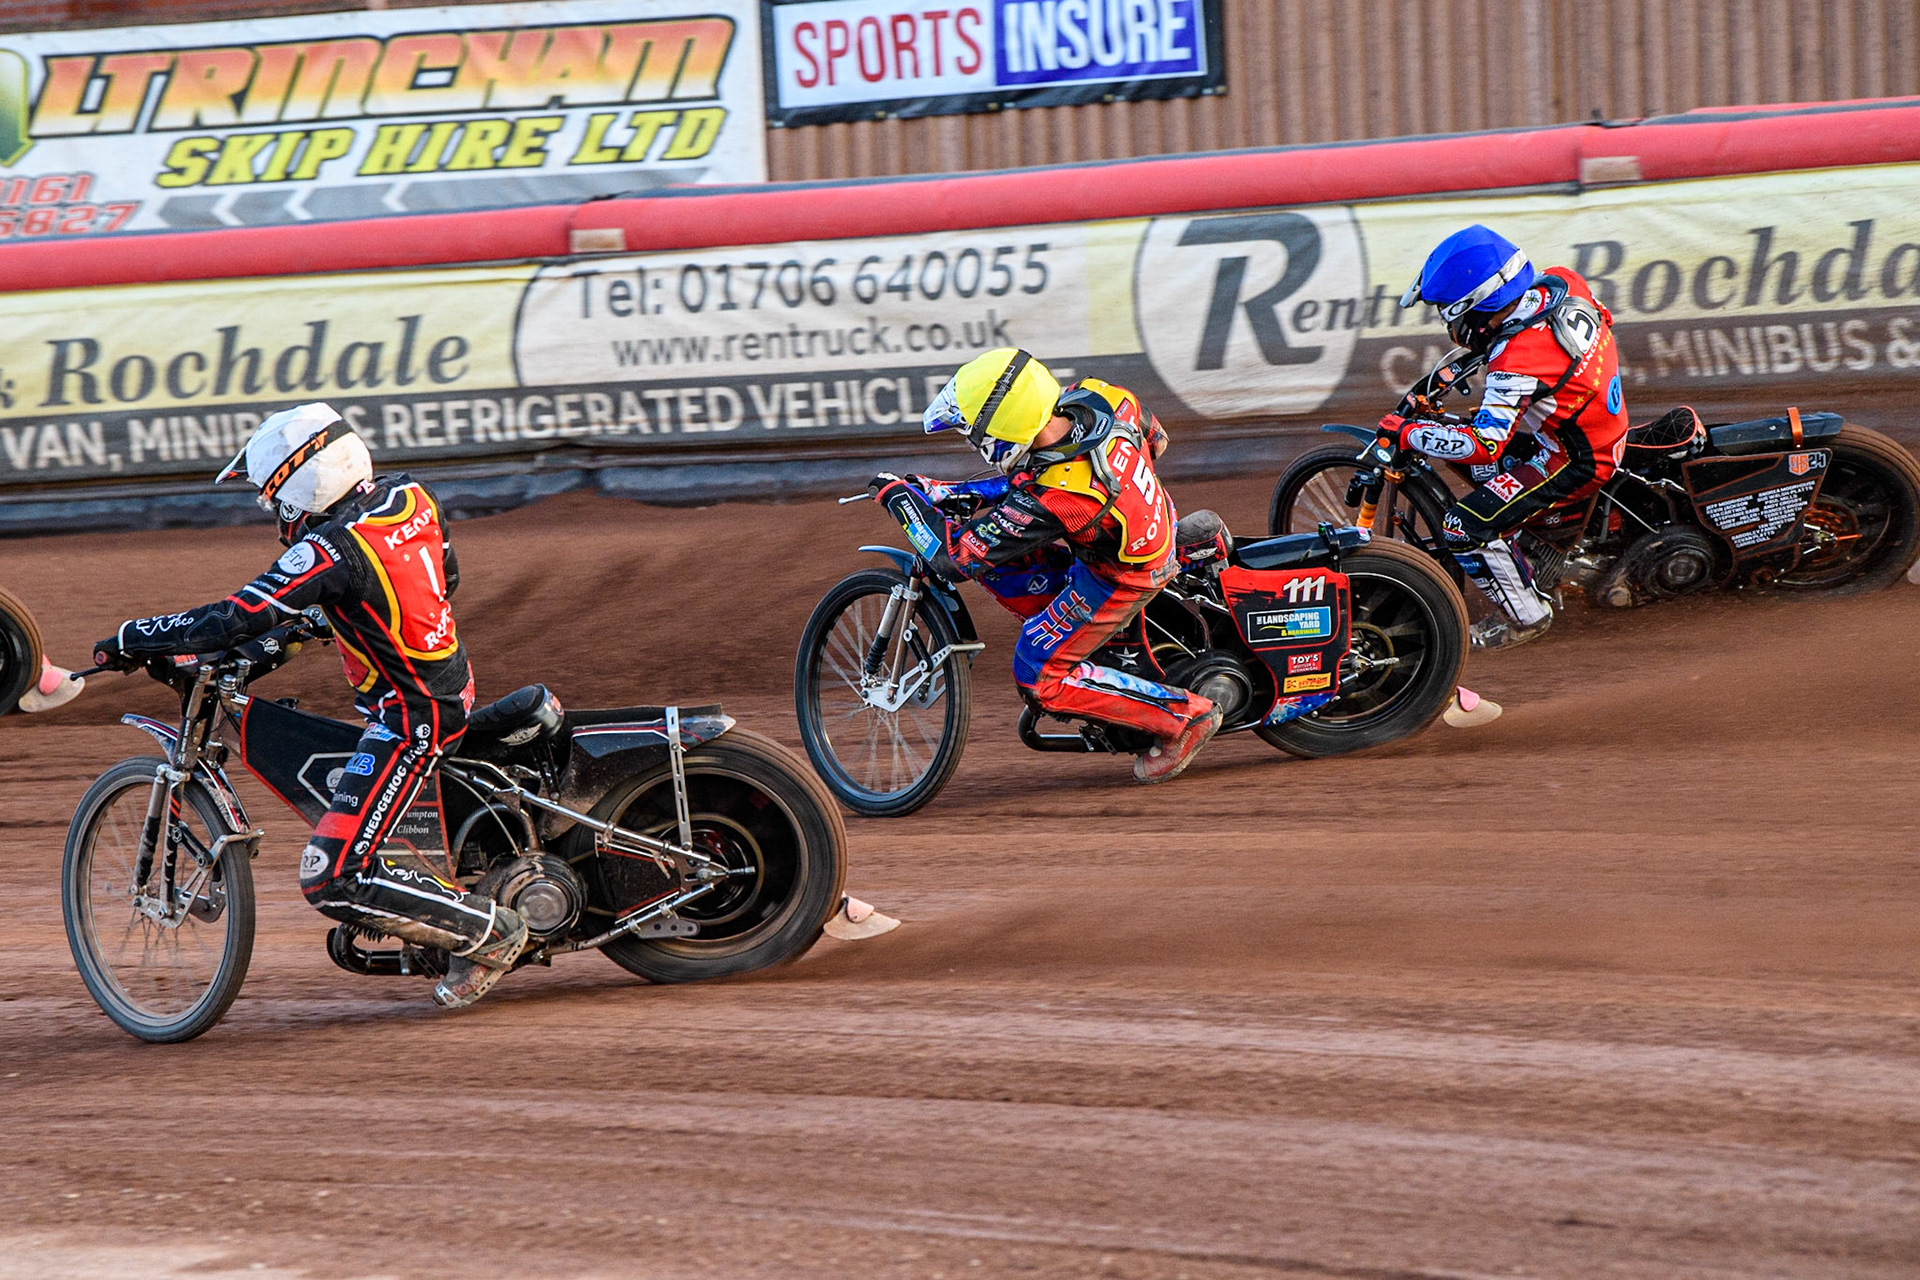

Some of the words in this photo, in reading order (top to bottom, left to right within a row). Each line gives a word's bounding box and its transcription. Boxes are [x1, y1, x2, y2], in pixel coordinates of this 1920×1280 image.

[794, 7, 982, 89] SPORTS
[1006, 0, 1191, 74] INSURE
[157, 127, 356, 188] SKIP
[357, 116, 561, 176] HIRE
[570, 107, 729, 166] LTD
[0, 173, 93, 206] 161
[576, 268, 663, 319] Tel:
[678, 257, 838, 314] 01706
[852, 243, 1051, 304] 640055
[39, 315, 469, 407] Rochdale
[611, 311, 1012, 367] www.rentruck.co.uk
[1650, 318, 1876, 378] MINIBUS
[1, 420, 123, 472] VAN,
[383, 386, 742, 448] REFRIGERATED
[1420, 430, 1466, 452] FRP
[264, 430, 330, 500] COTT
[1131, 453, 1158, 506] 5
[967, 532, 987, 552] TOY'S
[418, 545, 444, 603] 1
[1283, 575, 1326, 603] 111
[1262, 611, 1320, 625] LANDSCAPING
[1299, 620, 1320, 629] YARD
[1291, 653, 1319, 665] TOY'S
[362, 765, 407, 840] HEDGEHOG
[406, 811, 438, 822] umpton
